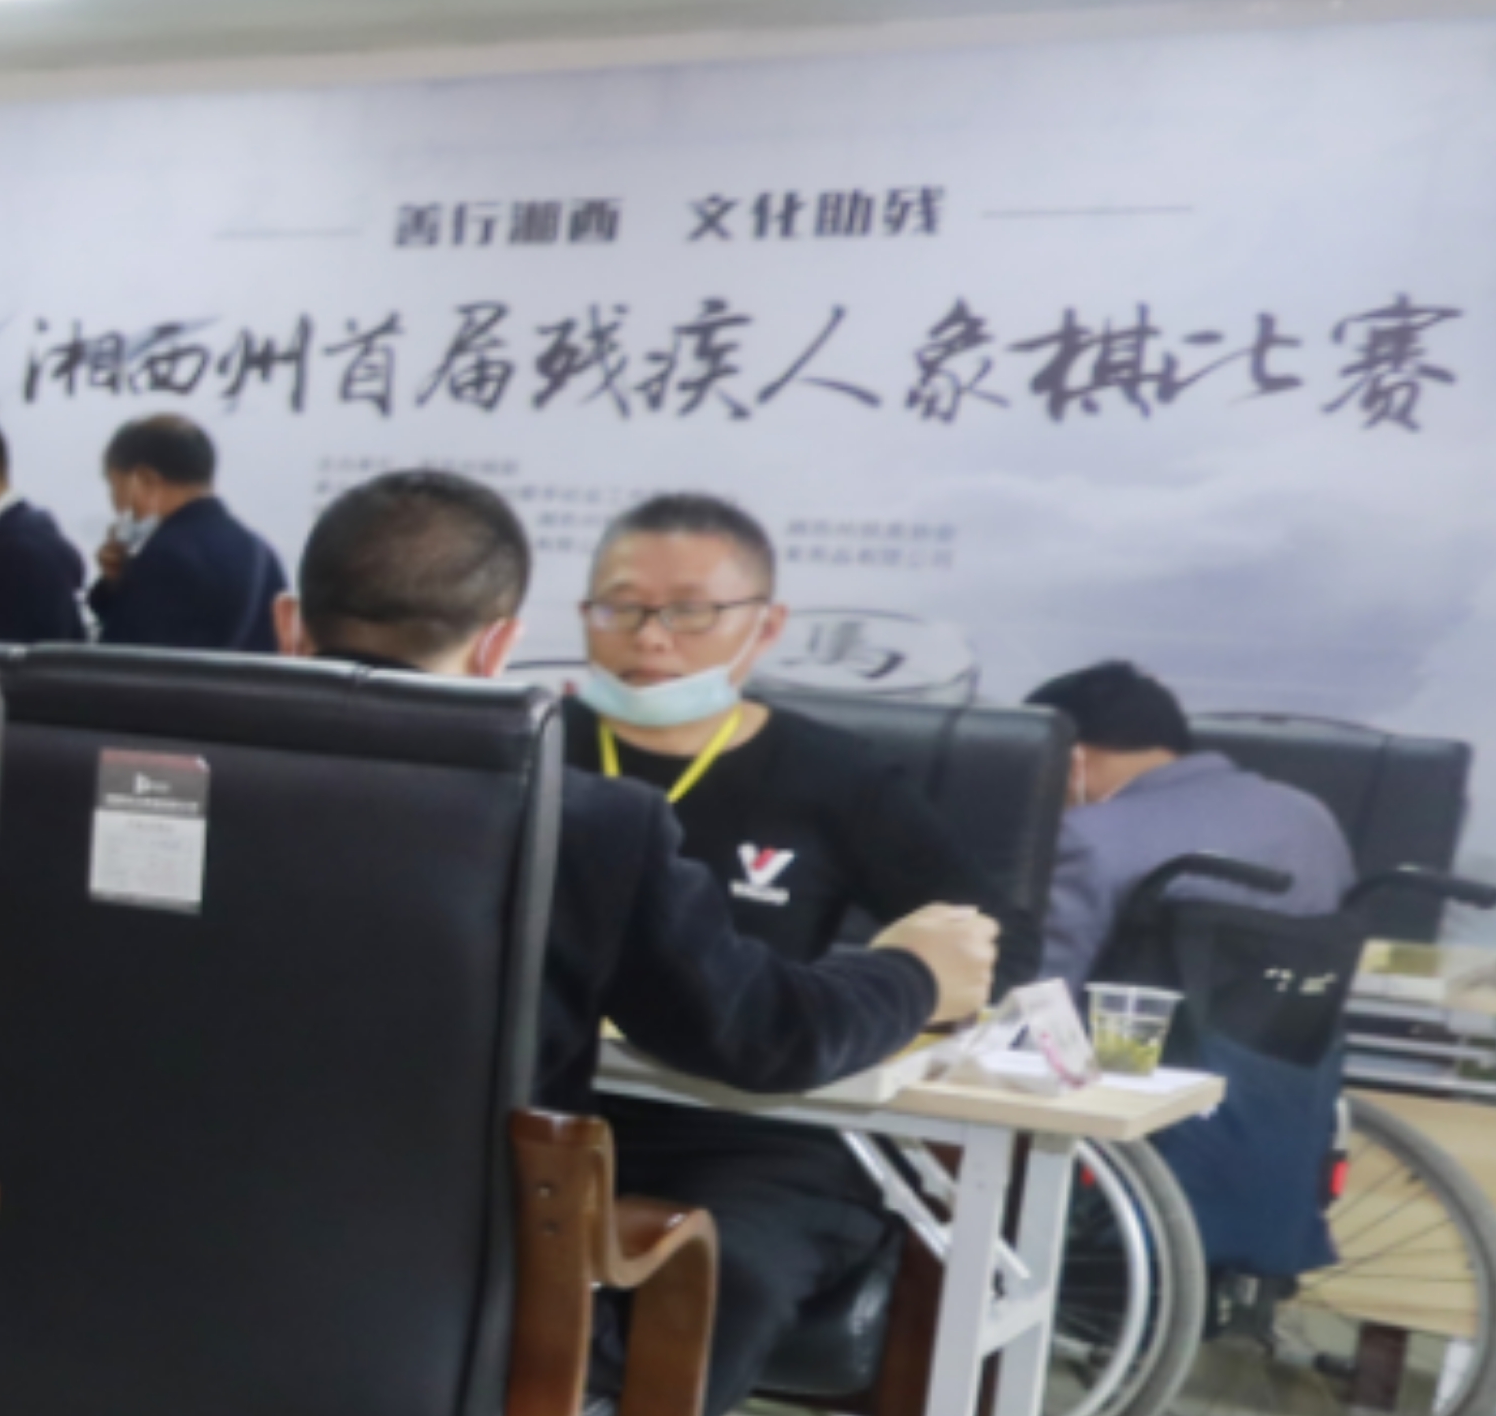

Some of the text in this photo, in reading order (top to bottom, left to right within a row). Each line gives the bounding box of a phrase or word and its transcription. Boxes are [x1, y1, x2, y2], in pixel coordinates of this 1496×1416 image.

[21, 291, 1466, 435] 湘西州首届残疾人象棋比赛
